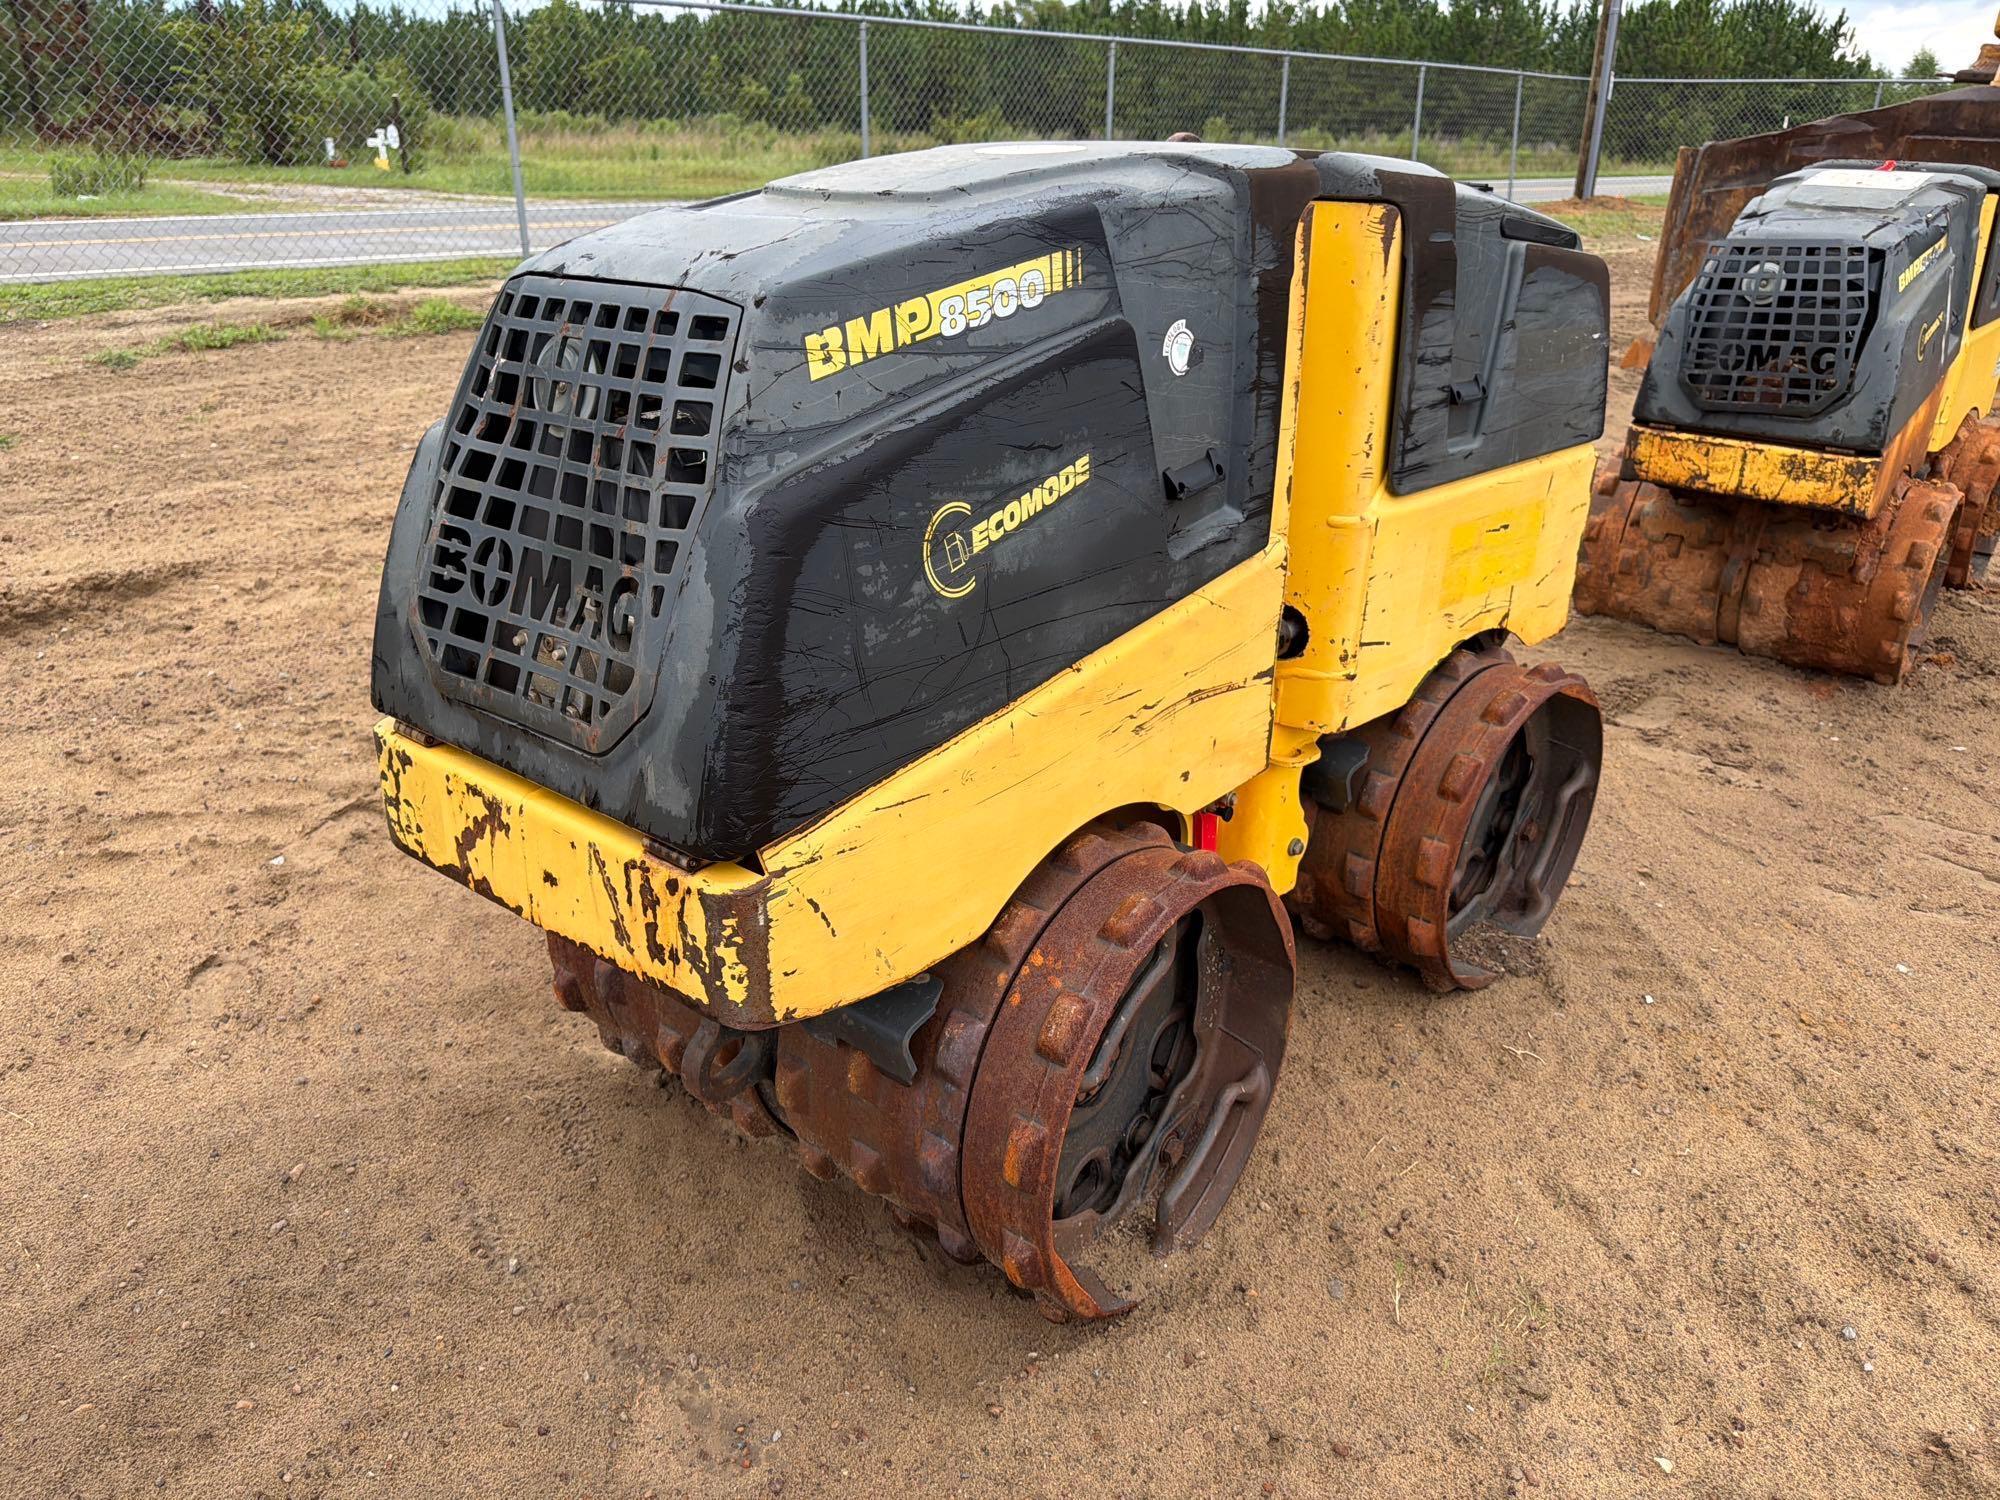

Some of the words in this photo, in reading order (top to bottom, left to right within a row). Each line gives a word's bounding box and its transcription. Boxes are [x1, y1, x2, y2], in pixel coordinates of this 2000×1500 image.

[805, 296, 932, 382] BMP
[938, 268, 1046, 338] 8500
[1693, 342, 1838, 375] BOMAG
[971, 453, 1090, 555] ECOMODE
[428, 523, 641, 653] BOMAG
